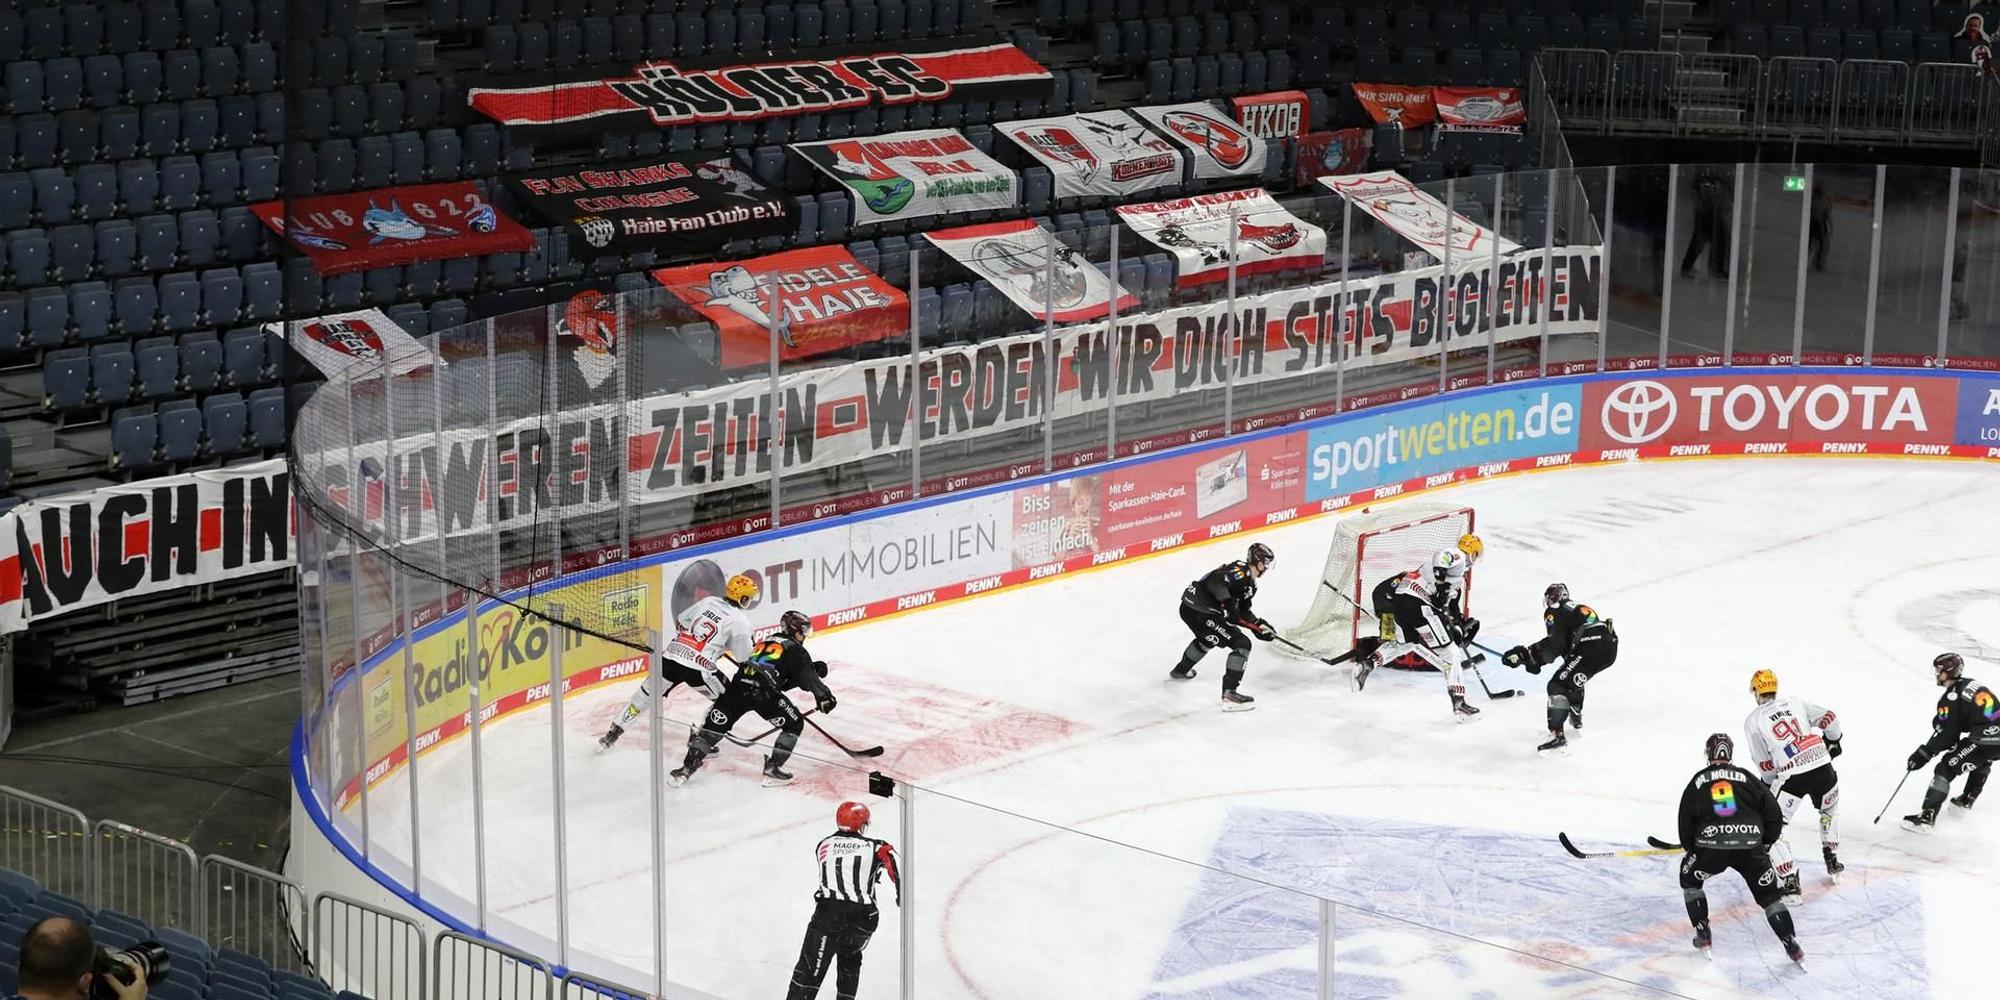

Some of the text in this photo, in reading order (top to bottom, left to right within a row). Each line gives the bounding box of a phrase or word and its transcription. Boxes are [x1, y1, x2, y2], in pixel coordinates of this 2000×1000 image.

[1378, 91, 1404, 102] SIND
[1242, 102, 1301, 139] HK08
[580, 161, 693, 189] SHARKS
[622, 200, 786, 236] Haie Fan Club e.V.
[754, 263, 868, 297] FIDELE
[782, 286, 882, 323] HAIE
[1706, 356, 1720, 364] OTT
[1356, 397, 1368, 407] OTT
[1690, 384, 1929, 432] TOYOTA
[1305, 407, 1317, 417] OTT
[1251, 418, 1264, 428] OTT
[16, 484, 198, 619] AUCH
[222, 472, 290, 570] IN
[647, 384, 818, 492] ZEITEN
[865, 340, 1063, 450] WERDEN
[1076, 323, 1164, 401] WIR
[1174, 307, 1267, 389] DICH
[1284, 284, 1396, 372] STETS
[1409, 255, 1602, 348] BEGLEITEN
[1196, 429, 1209, 439] OTT
[1312, 392, 1574, 489] sportwetten.de
[1140, 440, 1153, 450] OTT
[1080, 452, 1094, 462] OTT
[1018, 465, 1032, 475] OTT
[955, 477, 968, 488] OTT
[1109, 482, 1135, 496] Mit der
[890, 490, 904, 500] OTT
[823, 503, 837, 514] OTT
[1022, 494, 1051, 515] Biss
[752, 517, 768, 529] OTT
[1021, 515, 1066, 537] zeigen
[681, 532, 696, 543] OTT
[606, 548, 622, 560] OTT
[811, 520, 998, 592] IMMOBILIEN
[611, 597, 640, 612] Radio
[1214, 624, 1233, 641] Hilux
[501, 615, 583, 671] Kön
[1566, 655, 1583, 673] Hilux
[1772, 717, 1805, 742] 91
[1958, 743, 1978, 760] Hilux
[1710, 780, 1738, 818] 9
[1718, 824, 1762, 835] TOYOTA
